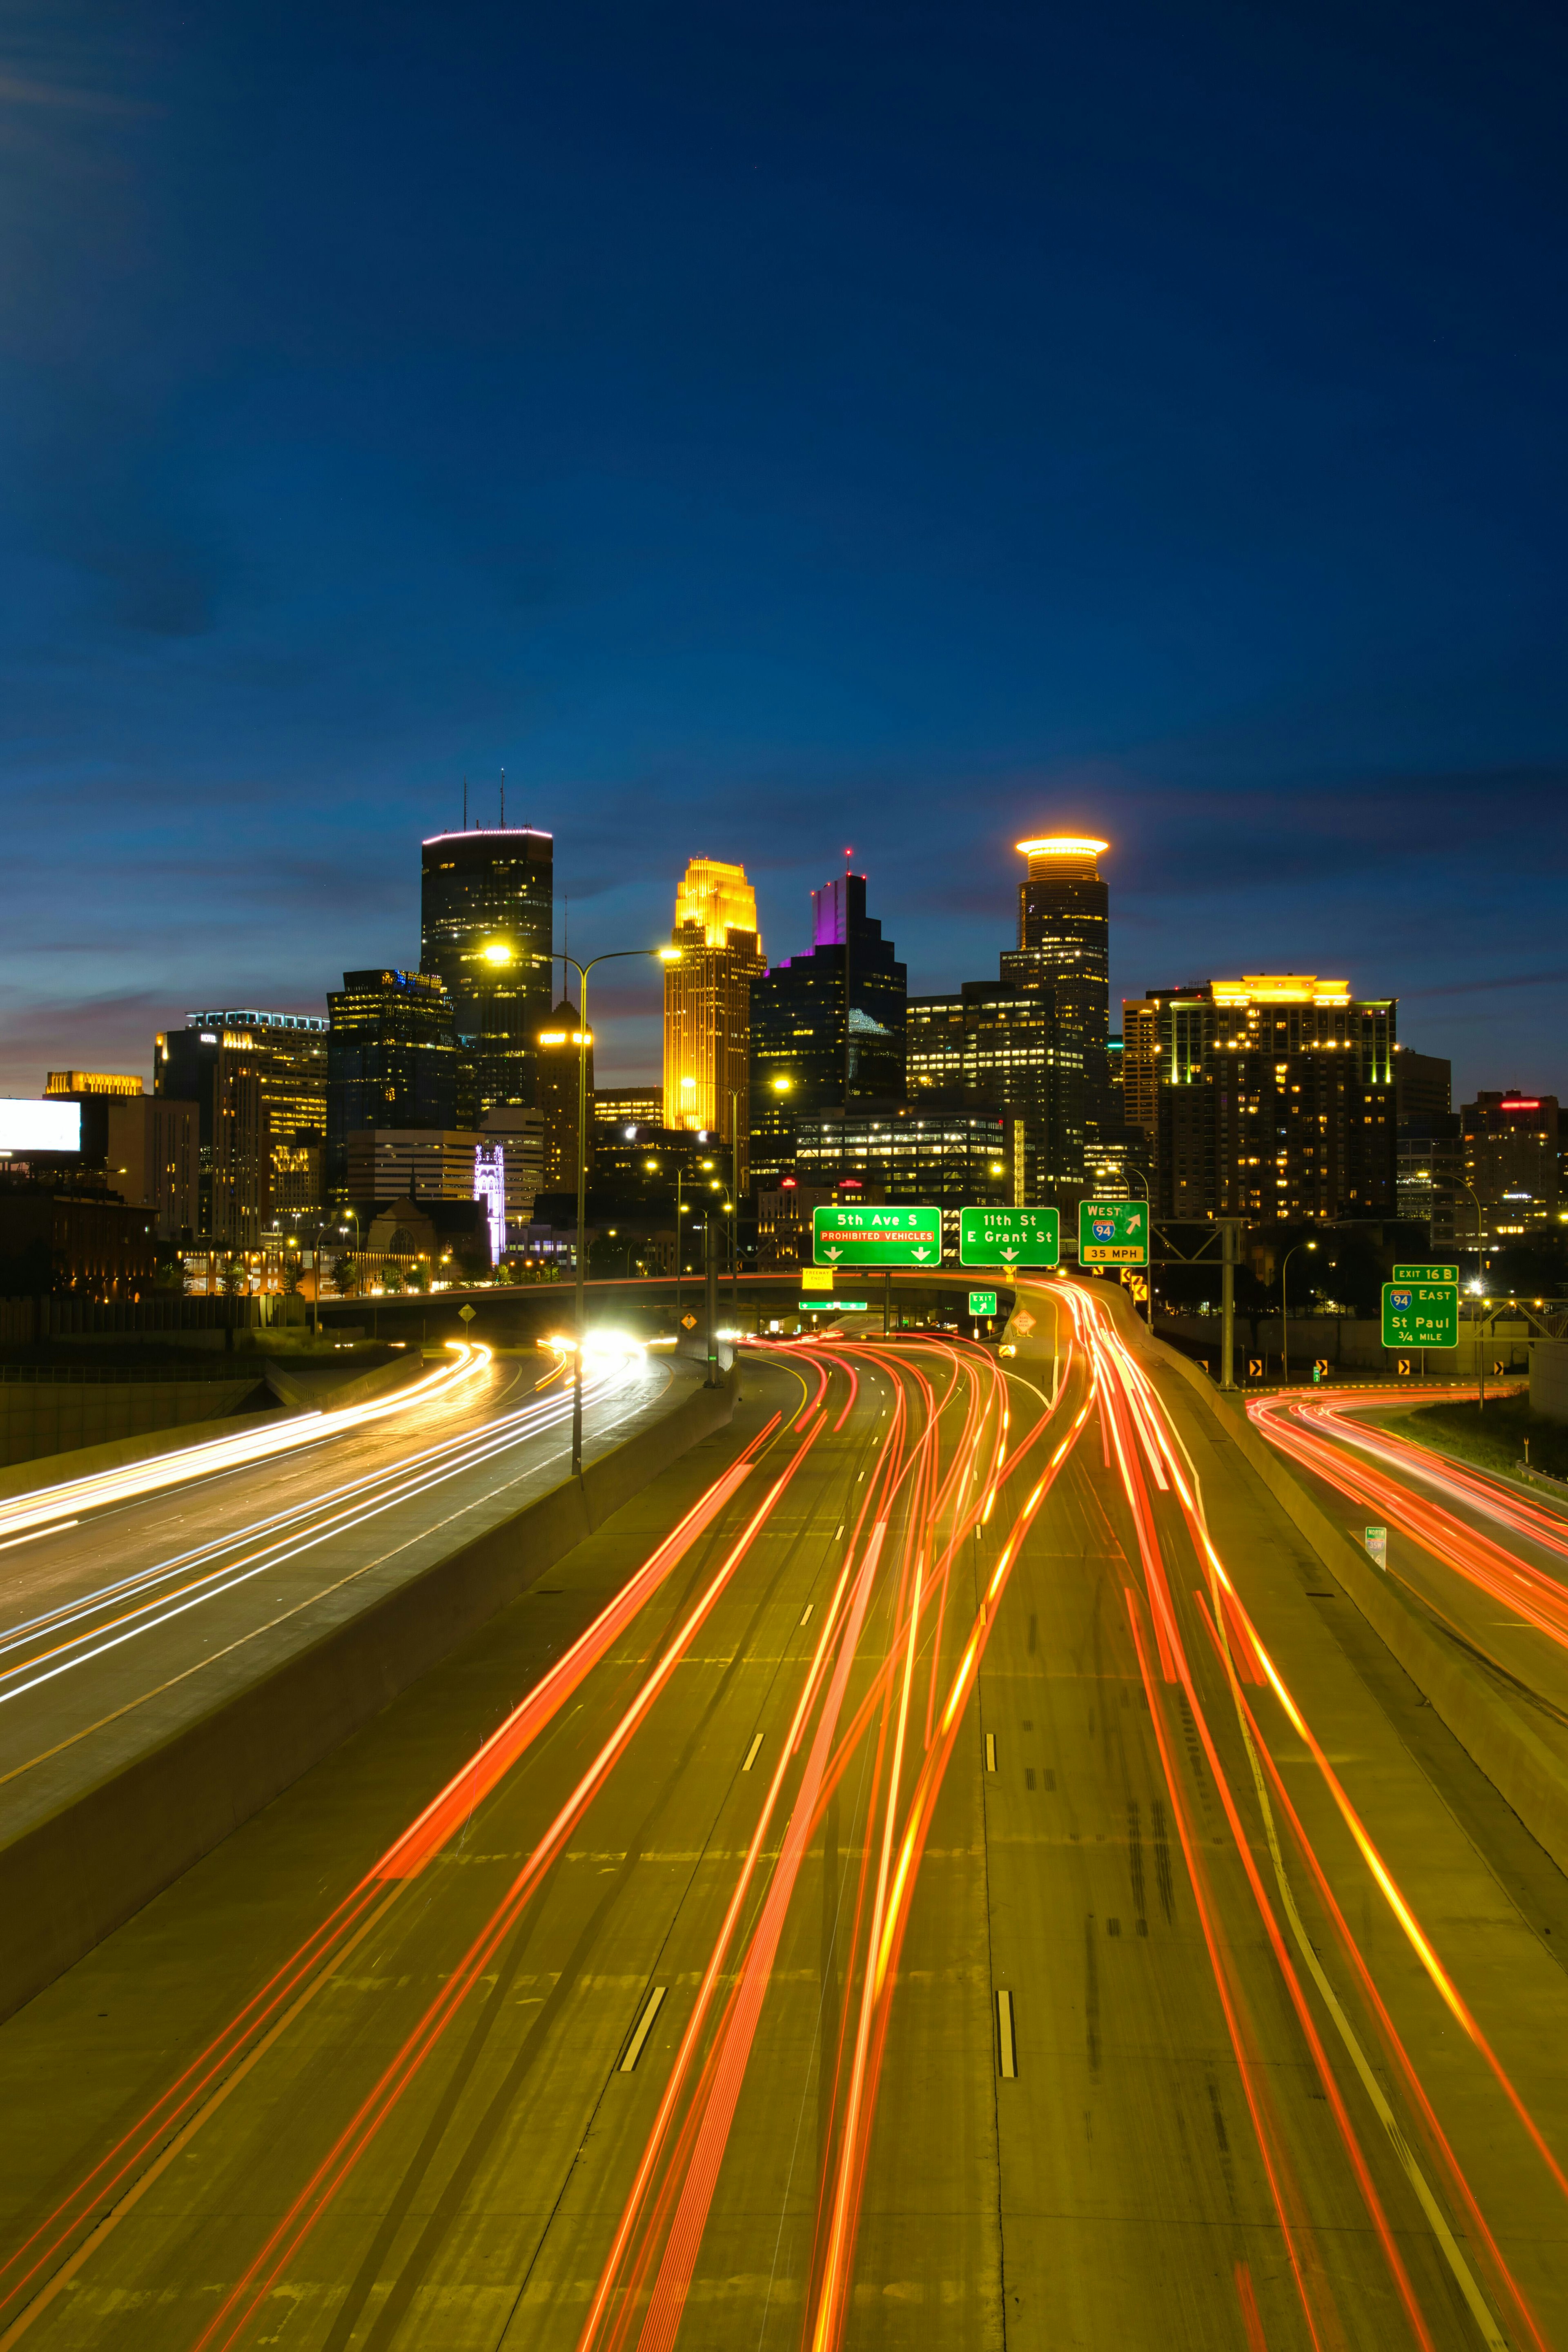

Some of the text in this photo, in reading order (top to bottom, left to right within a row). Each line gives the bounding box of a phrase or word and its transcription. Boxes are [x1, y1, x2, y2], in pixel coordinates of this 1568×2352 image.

[201, 1034, 216, 1042] HOTEL
[1087, 1205, 1120, 1216] WEST
[837, 1214, 917, 1226] 5th Ave S
[984, 1215, 1036, 1226] 11th St
[1096, 1226, 1111, 1236] 94
[967, 1231, 1052, 1243] E Grant St
[1091, 1250, 1106, 1258] 35
[1426, 1269, 1439, 1279] 16
[1443, 1269, 1452, 1280] B
[1419, 1290, 1450, 1300] EAST
[1394, 1296, 1408, 1306] 94
[1392, 1317, 1449, 1328] St Paul
[1399, 1332, 1413, 1342] 3/4
